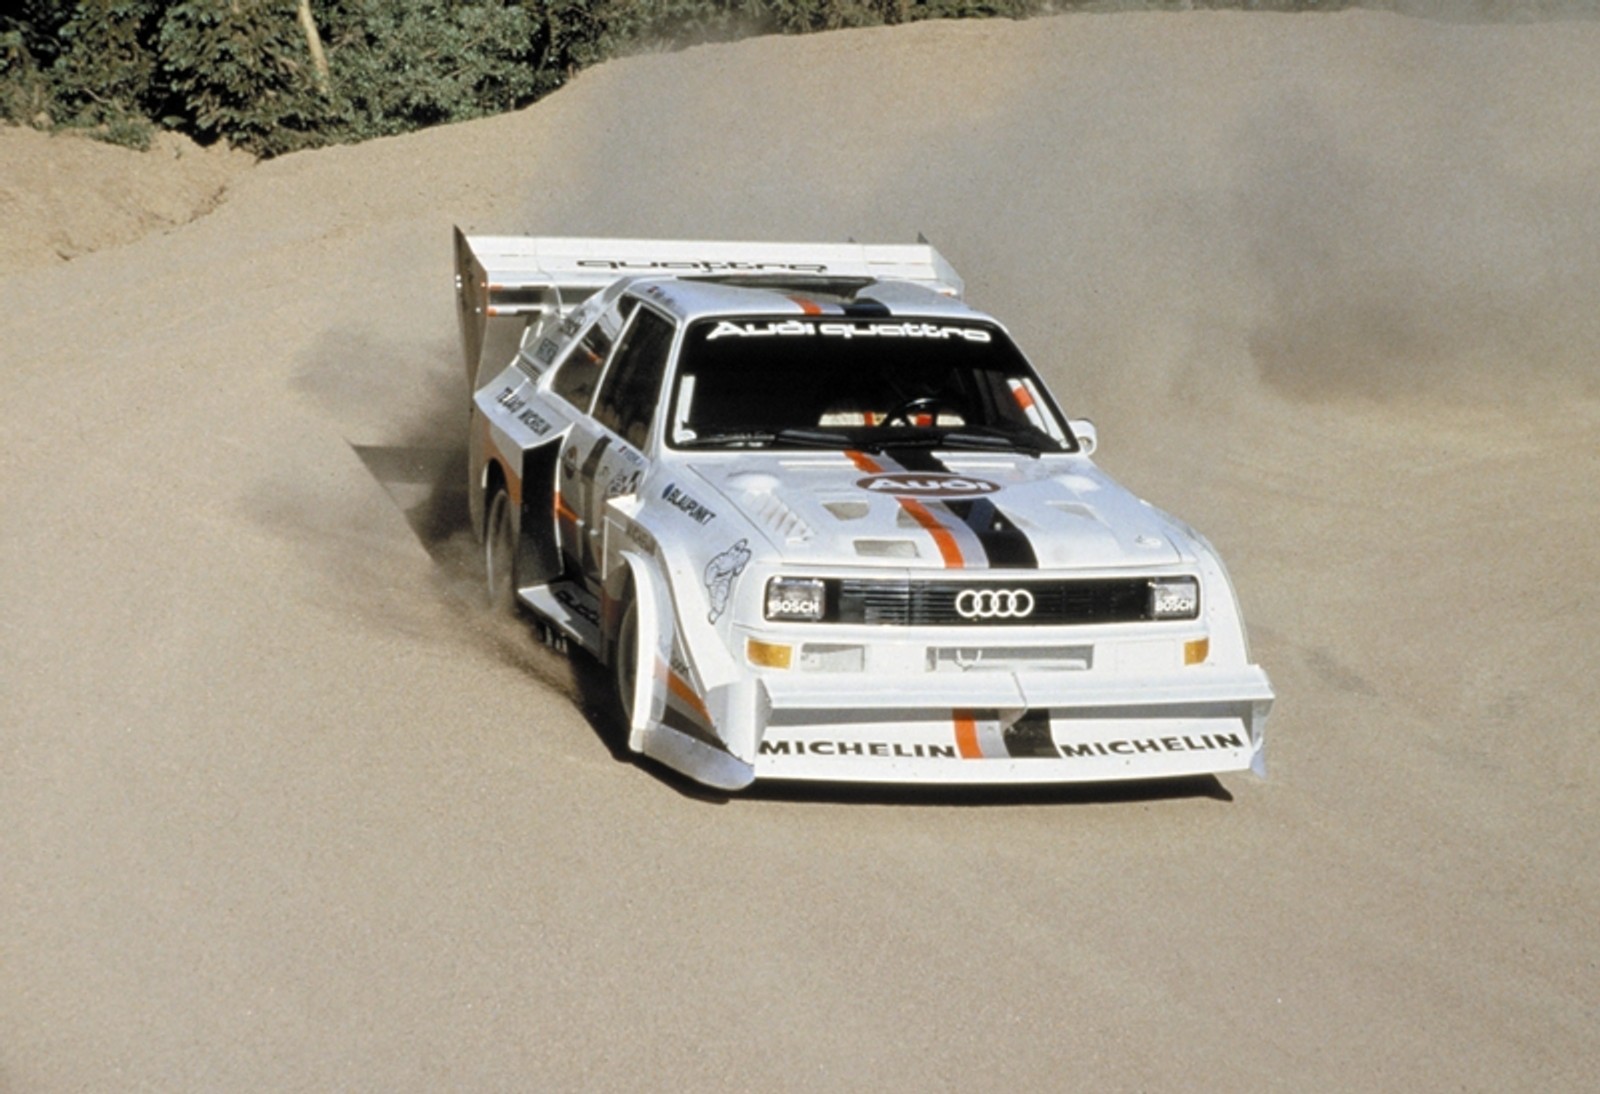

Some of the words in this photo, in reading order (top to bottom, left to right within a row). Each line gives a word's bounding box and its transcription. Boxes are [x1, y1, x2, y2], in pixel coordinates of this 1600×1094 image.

[577, 260, 827, 272] quattro
[706, 320, 815, 340] Audi
[819, 323, 991, 342] quattro
[667, 488, 716, 526] BLAUPUNKT
[767, 600, 819, 613] BOSCH
[758, 740, 956, 758] MICHELIN
[1059, 733, 1244, 758] MICHELIN
